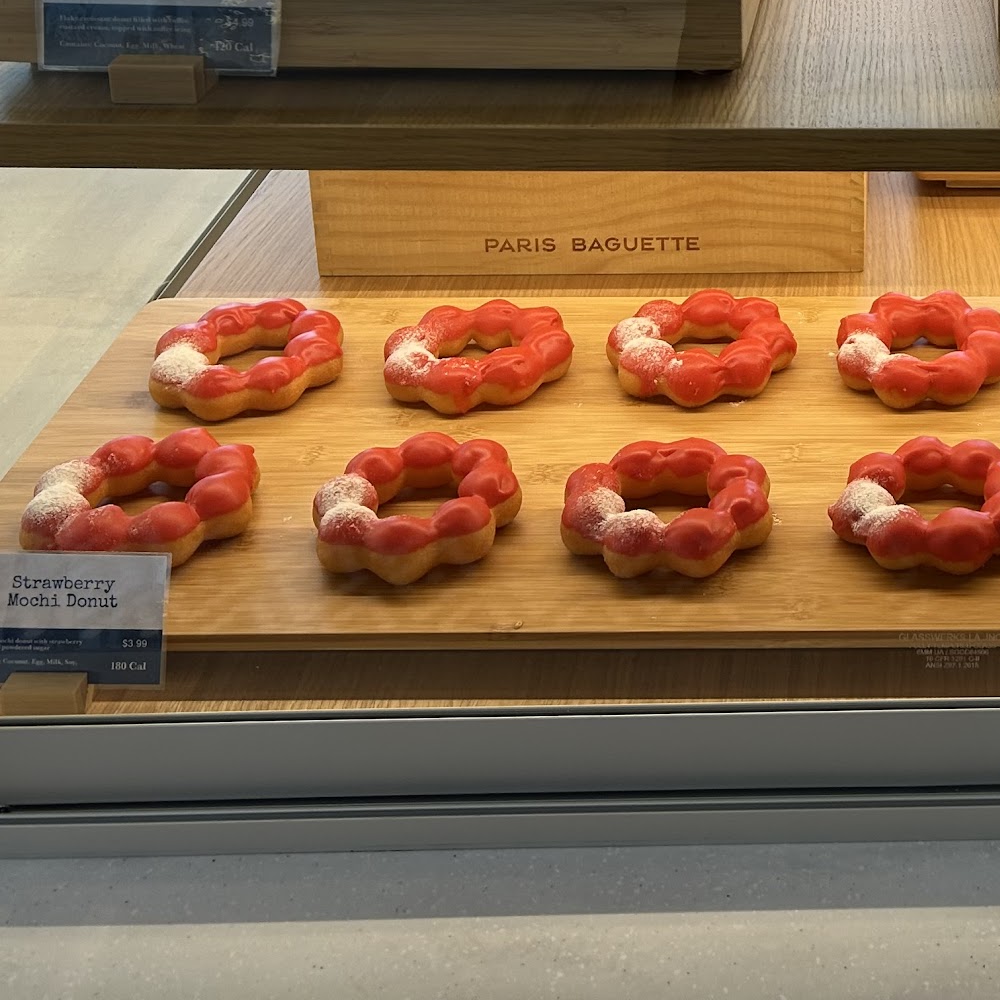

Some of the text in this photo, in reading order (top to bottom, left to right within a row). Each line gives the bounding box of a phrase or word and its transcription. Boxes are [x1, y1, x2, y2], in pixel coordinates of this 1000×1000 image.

[235, 42, 254, 52] Cal
[484, 236, 701, 253] PARIS BAGUETTE
[12, 575, 116, 593] Strawberry
[7, 593, 118, 608] Mochi Donut
[122, 639, 148, 649] $3.99
[111, 661, 147, 671] 180 Cal
